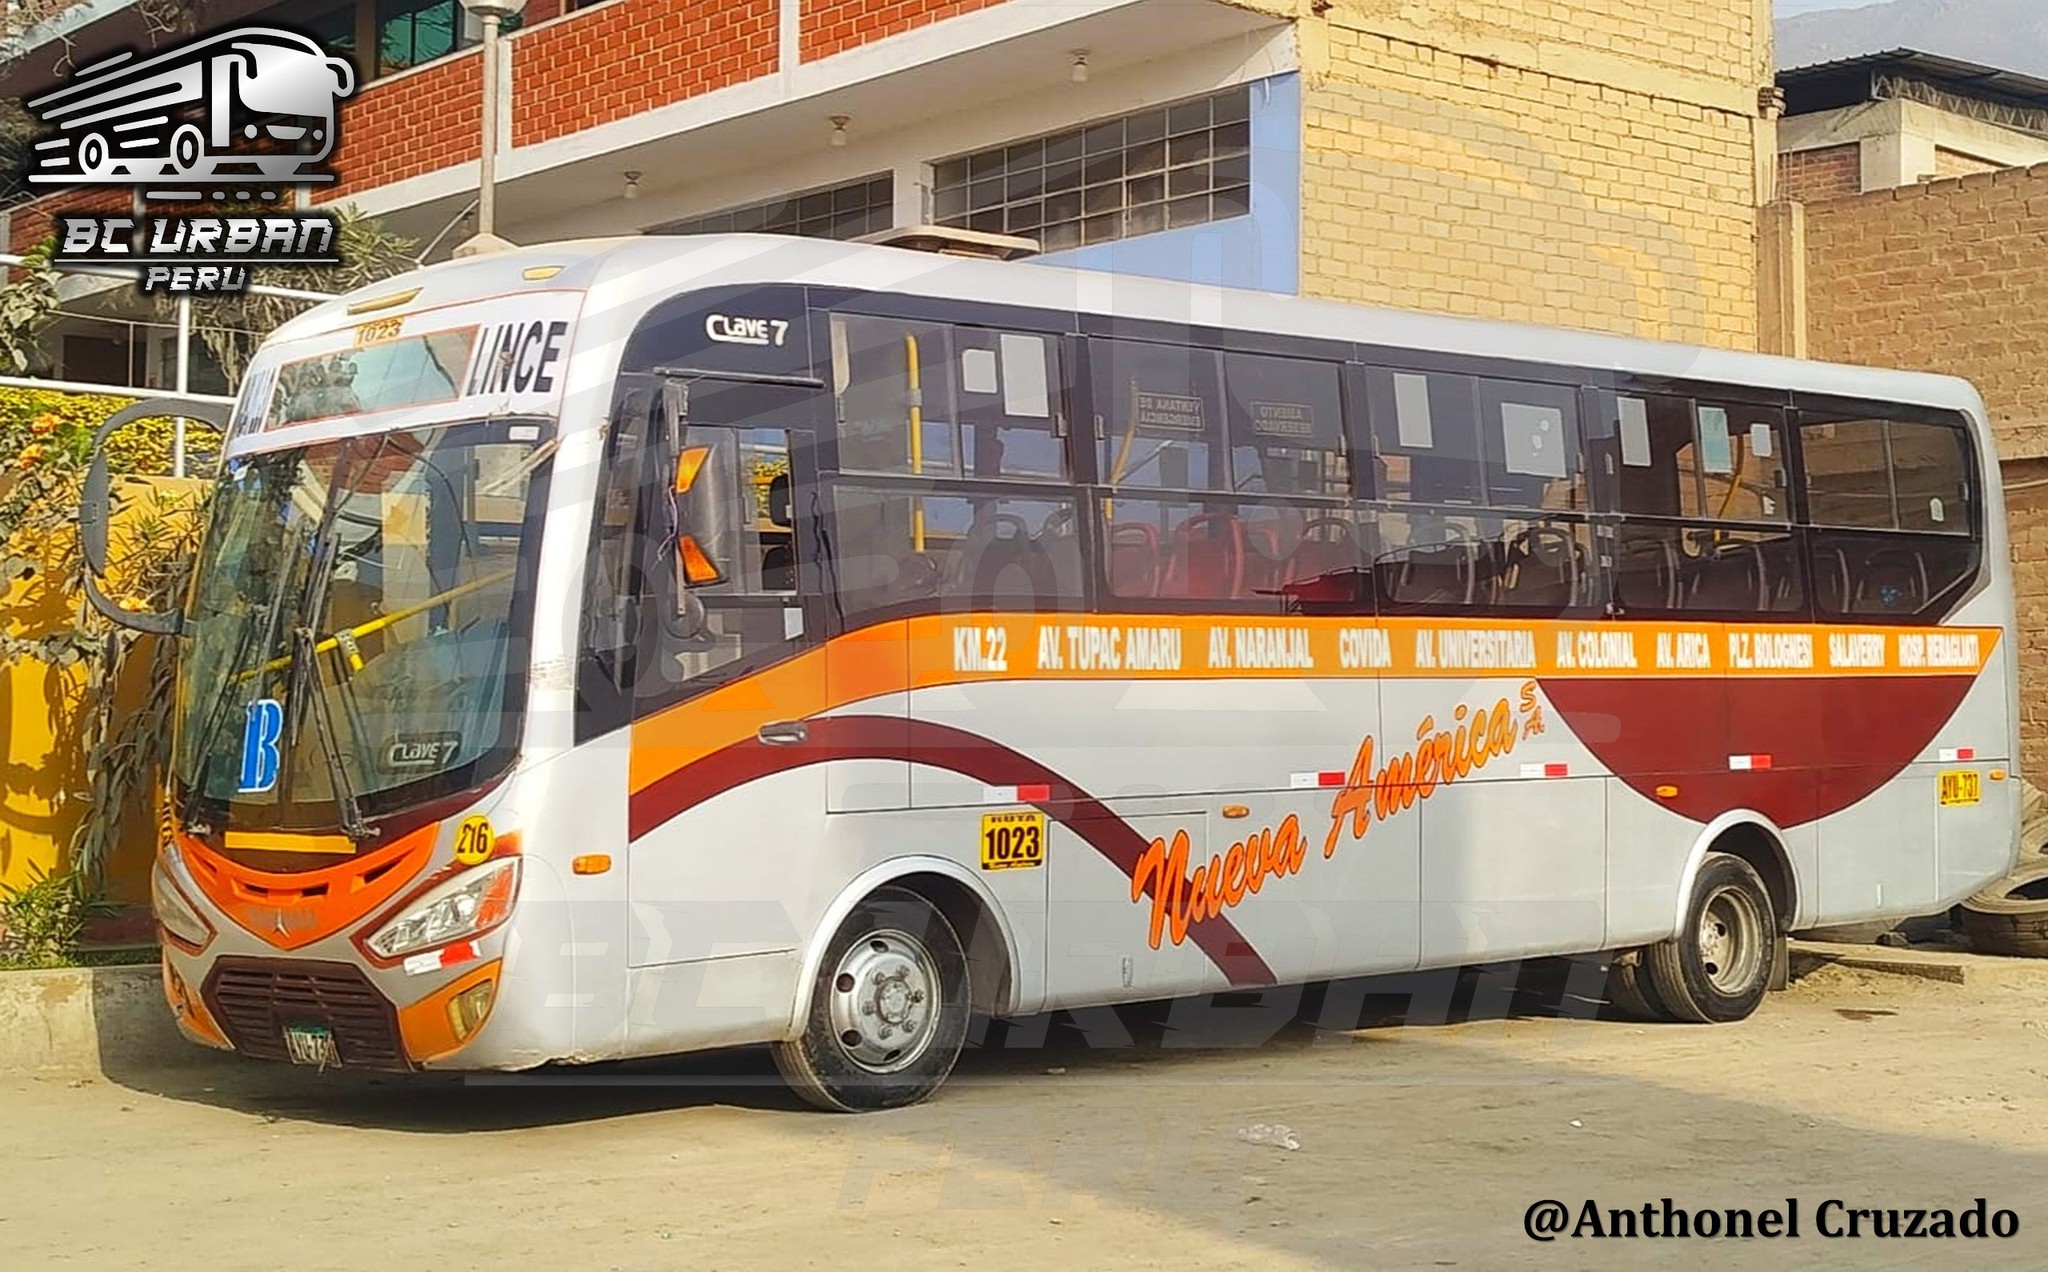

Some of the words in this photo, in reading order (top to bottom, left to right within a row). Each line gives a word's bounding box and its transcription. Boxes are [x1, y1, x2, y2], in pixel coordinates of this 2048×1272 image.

[356, 319, 402, 345] 1023
[769, 319, 789, 346] 7
[465, 320, 569, 397] LINCE
[953, 626, 1008, 672] KM.22
[1037, 626, 1064, 670] AV.
[1067, 627, 1121, 670] TUPAC
[1125, 627, 1182, 670] AMARU
[1208, 627, 1232, 668] AV.
[1234, 627, 1314, 669] NARANJAL
[1339, 628, 1392, 668] COVIDA
[1415, 629, 1436, 668] AV.
[1438, 629, 1537, 668] UNIVERSITARIA
[1556, 631, 1576, 668] AV.
[1577, 631, 1638, 668] COLONIAL
[1676, 632, 1711, 668] ARICA
[238, 698, 284, 793] B
[435, 740, 459, 765] 7
[1940, 773, 1980, 799] AYU-737
[456, 821, 490, 854] 216
[1131, 813, 1307, 950] Nueva
[1324, 698, 1519, 859] América
[985, 825, 1041, 860] 1023
